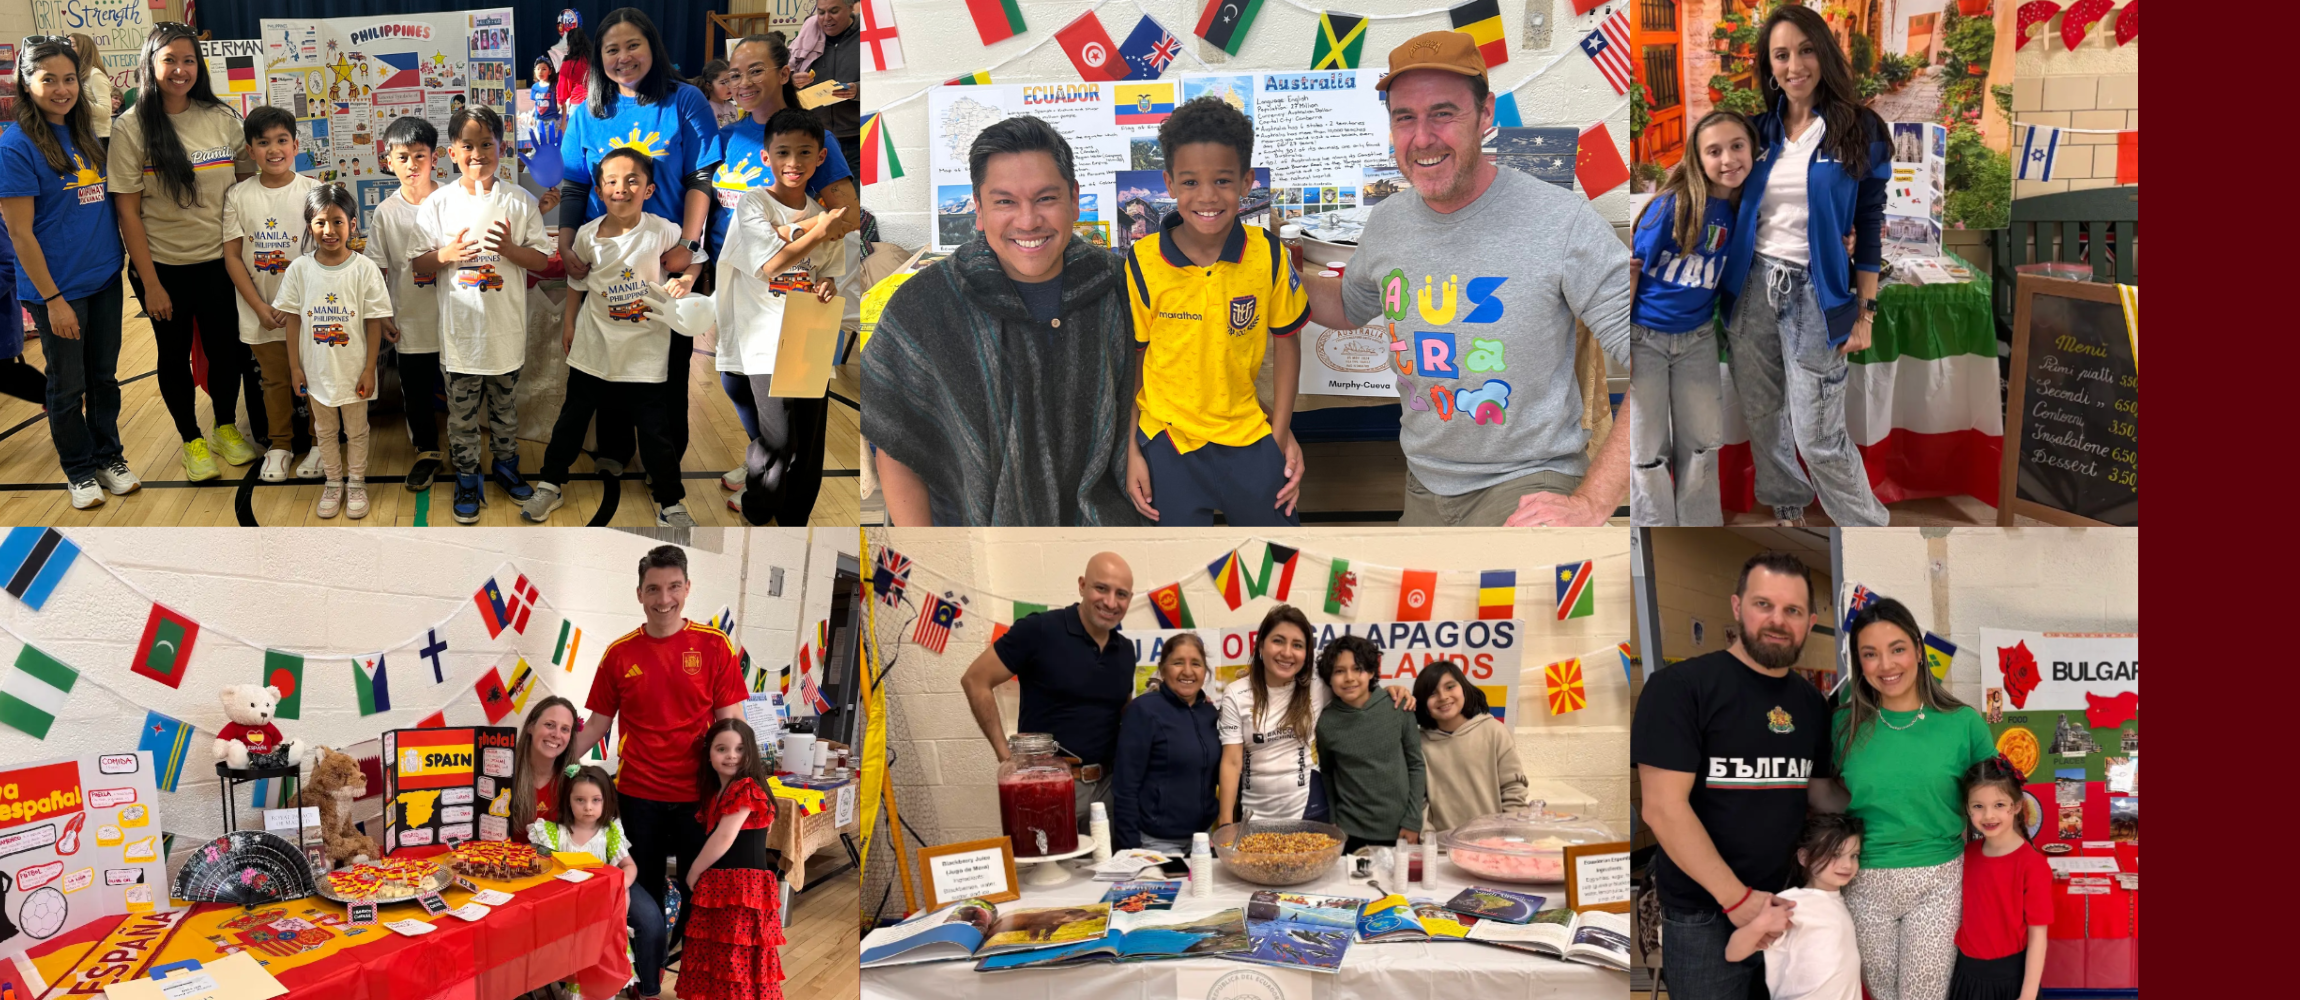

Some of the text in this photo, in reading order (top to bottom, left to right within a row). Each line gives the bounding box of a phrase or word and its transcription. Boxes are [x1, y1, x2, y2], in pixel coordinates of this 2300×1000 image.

[35, 0, 63, 30] GRIT
[66, 0, 142, 28] Strength
[351, 24, 431, 45] PHILIPPINES
[1265, 73, 1357, 91] Australia
[1023, 84, 1101, 105] ECUADOR
[1287, 95, 1309, 103] English
[254, 231, 290, 240] MANILA,
[608, 282, 649, 296] MANILA,
[609, 288, 649, 303] PHILIPPINES
[313, 305, 350, 315] MANILA,
[1159, 311, 1203, 321] marathon
[1337, 328, 1384, 339] AUSTRALIA
[2038, 354, 2075, 376] Primi
[2076, 367, 2115, 384] piatti
[1328, 380, 1391, 390] Murphy-Cueva
[2036, 378, 2091, 405] Secondi
[2031, 423, 2110, 458] Insalatone
[2031, 448, 2098, 477] Dessert
[2008, 716, 2028, 724] FOOD
[478, 731, 515, 749] ¡hola!
[1267, 727, 1293, 737] BANCO
[101, 757, 133, 766] COMIDA
[424, 752, 473, 768] SPAIN
[2053, 757, 2086, 765] PLACES
[66, 909, 181, 995] ESPAÑA
[1255, 976, 1280, 1000] ECUADOR
